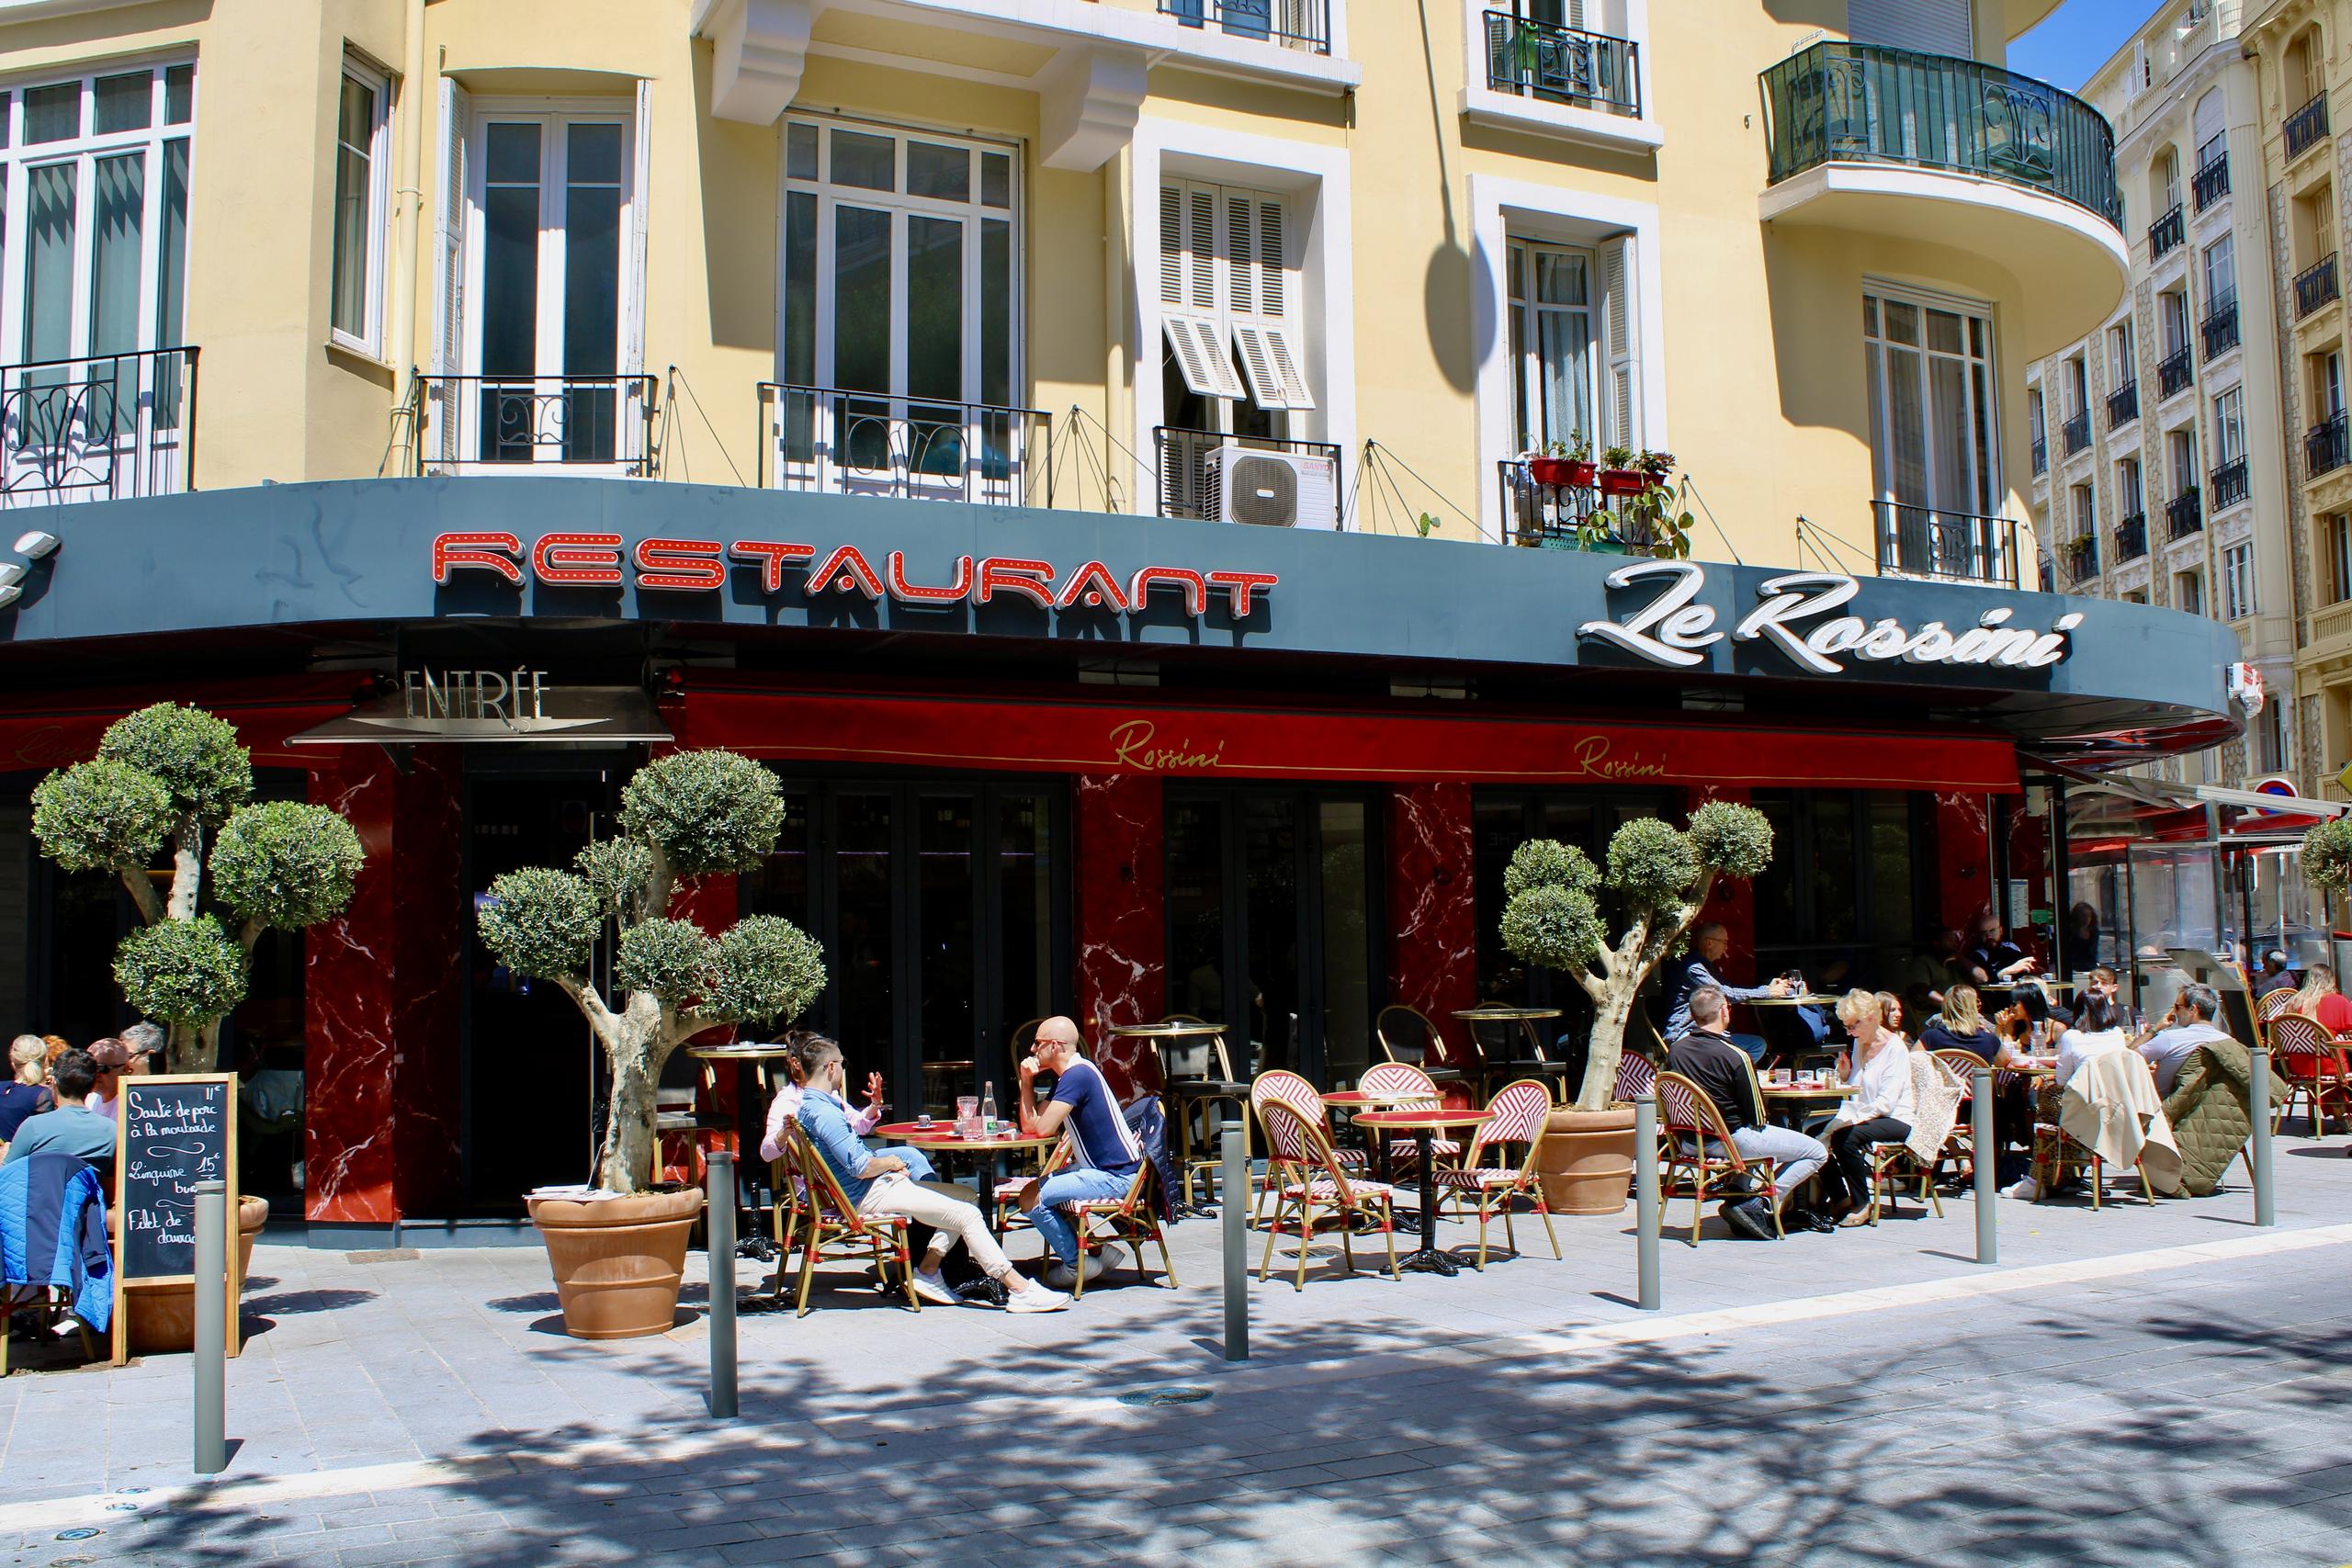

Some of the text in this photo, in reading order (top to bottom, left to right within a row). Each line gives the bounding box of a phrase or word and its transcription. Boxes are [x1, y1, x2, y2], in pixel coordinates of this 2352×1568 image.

[431, 531, 1280, 621] RESTAURANT
[1575, 558, 2085, 675] Le Rossini
[403, 663, 552, 732] ENTRÉE
[1109, 719, 1225, 771] Rossini
[1574, 735, 1667, 779] Rossini
[129, 1091, 218, 1123] Sauté de porc
[130, 1117, 217, 1138] à la moutarde
[129, 1161, 187, 1186] Linguine
[175, 1180, 198, 1194] bur
[128, 1209, 184, 1231] Filet de
[157, 1226, 197, 1245] daurad
